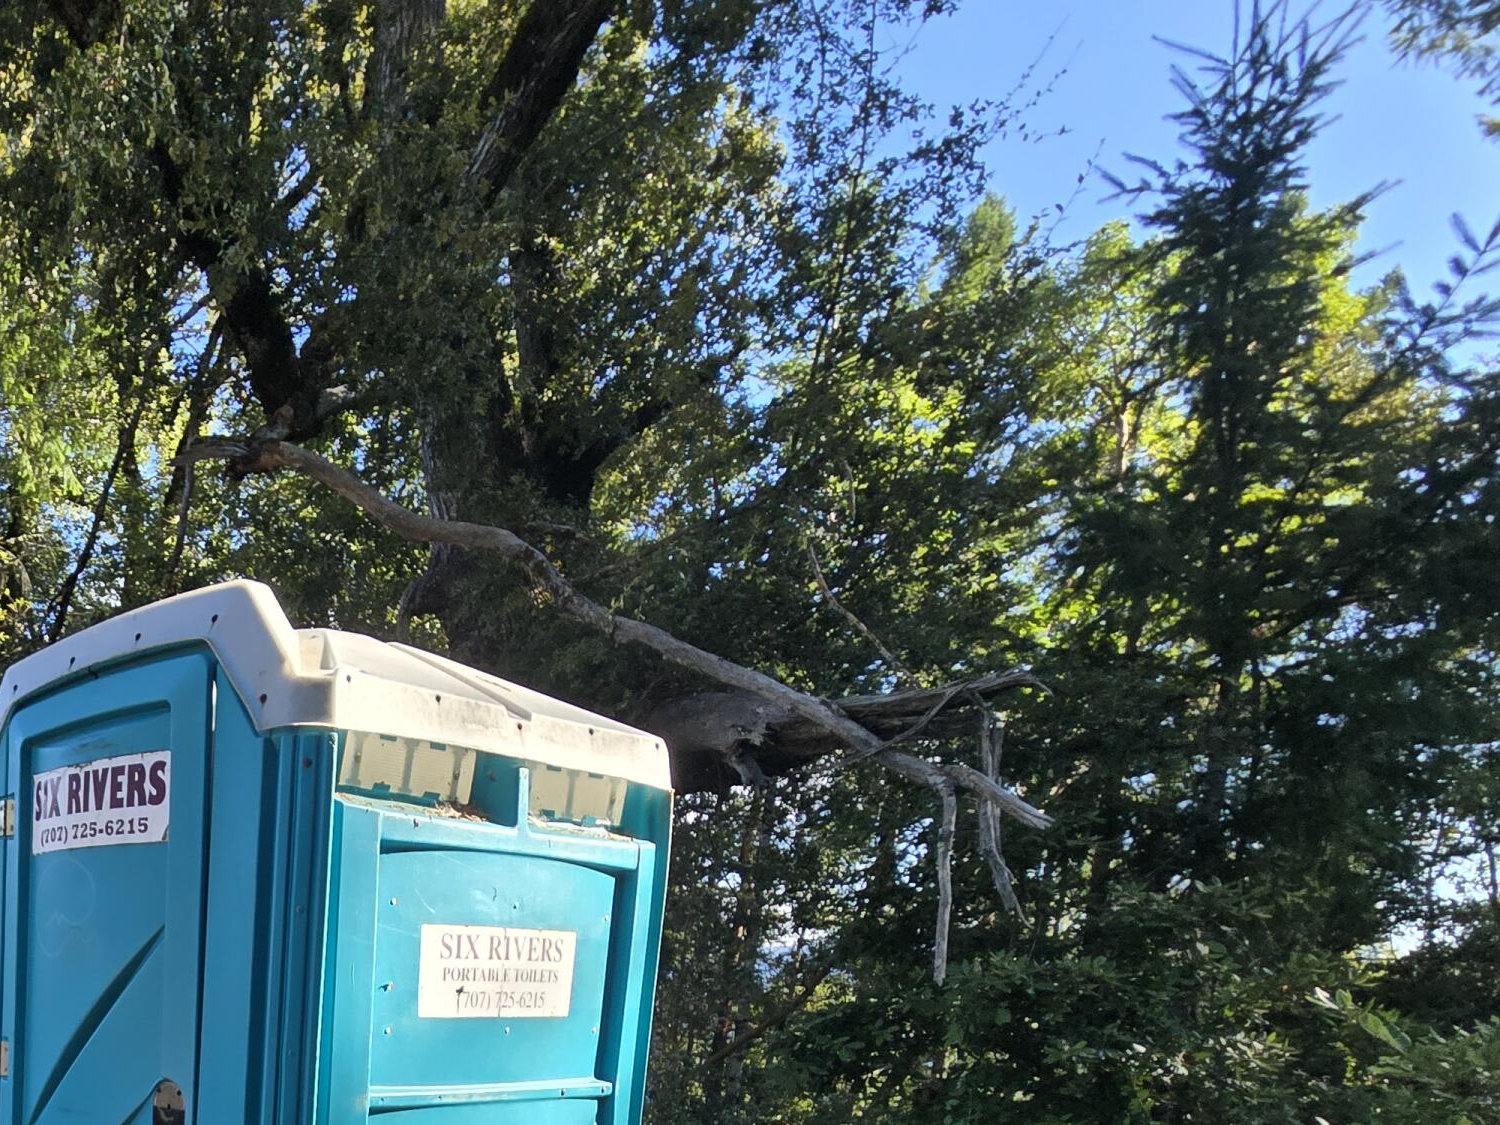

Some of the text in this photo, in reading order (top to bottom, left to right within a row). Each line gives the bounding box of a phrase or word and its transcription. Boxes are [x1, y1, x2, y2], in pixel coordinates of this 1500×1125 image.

[35, 760, 167, 821] SIX RIVERS
[40, 817, 148, 847] (707) 725-6215
[440, 932, 564, 963] SIX RIVERS
[442, 967, 559, 983] PORTABLE TOILETS
[495, 991, 545, 1009] 725-6215
